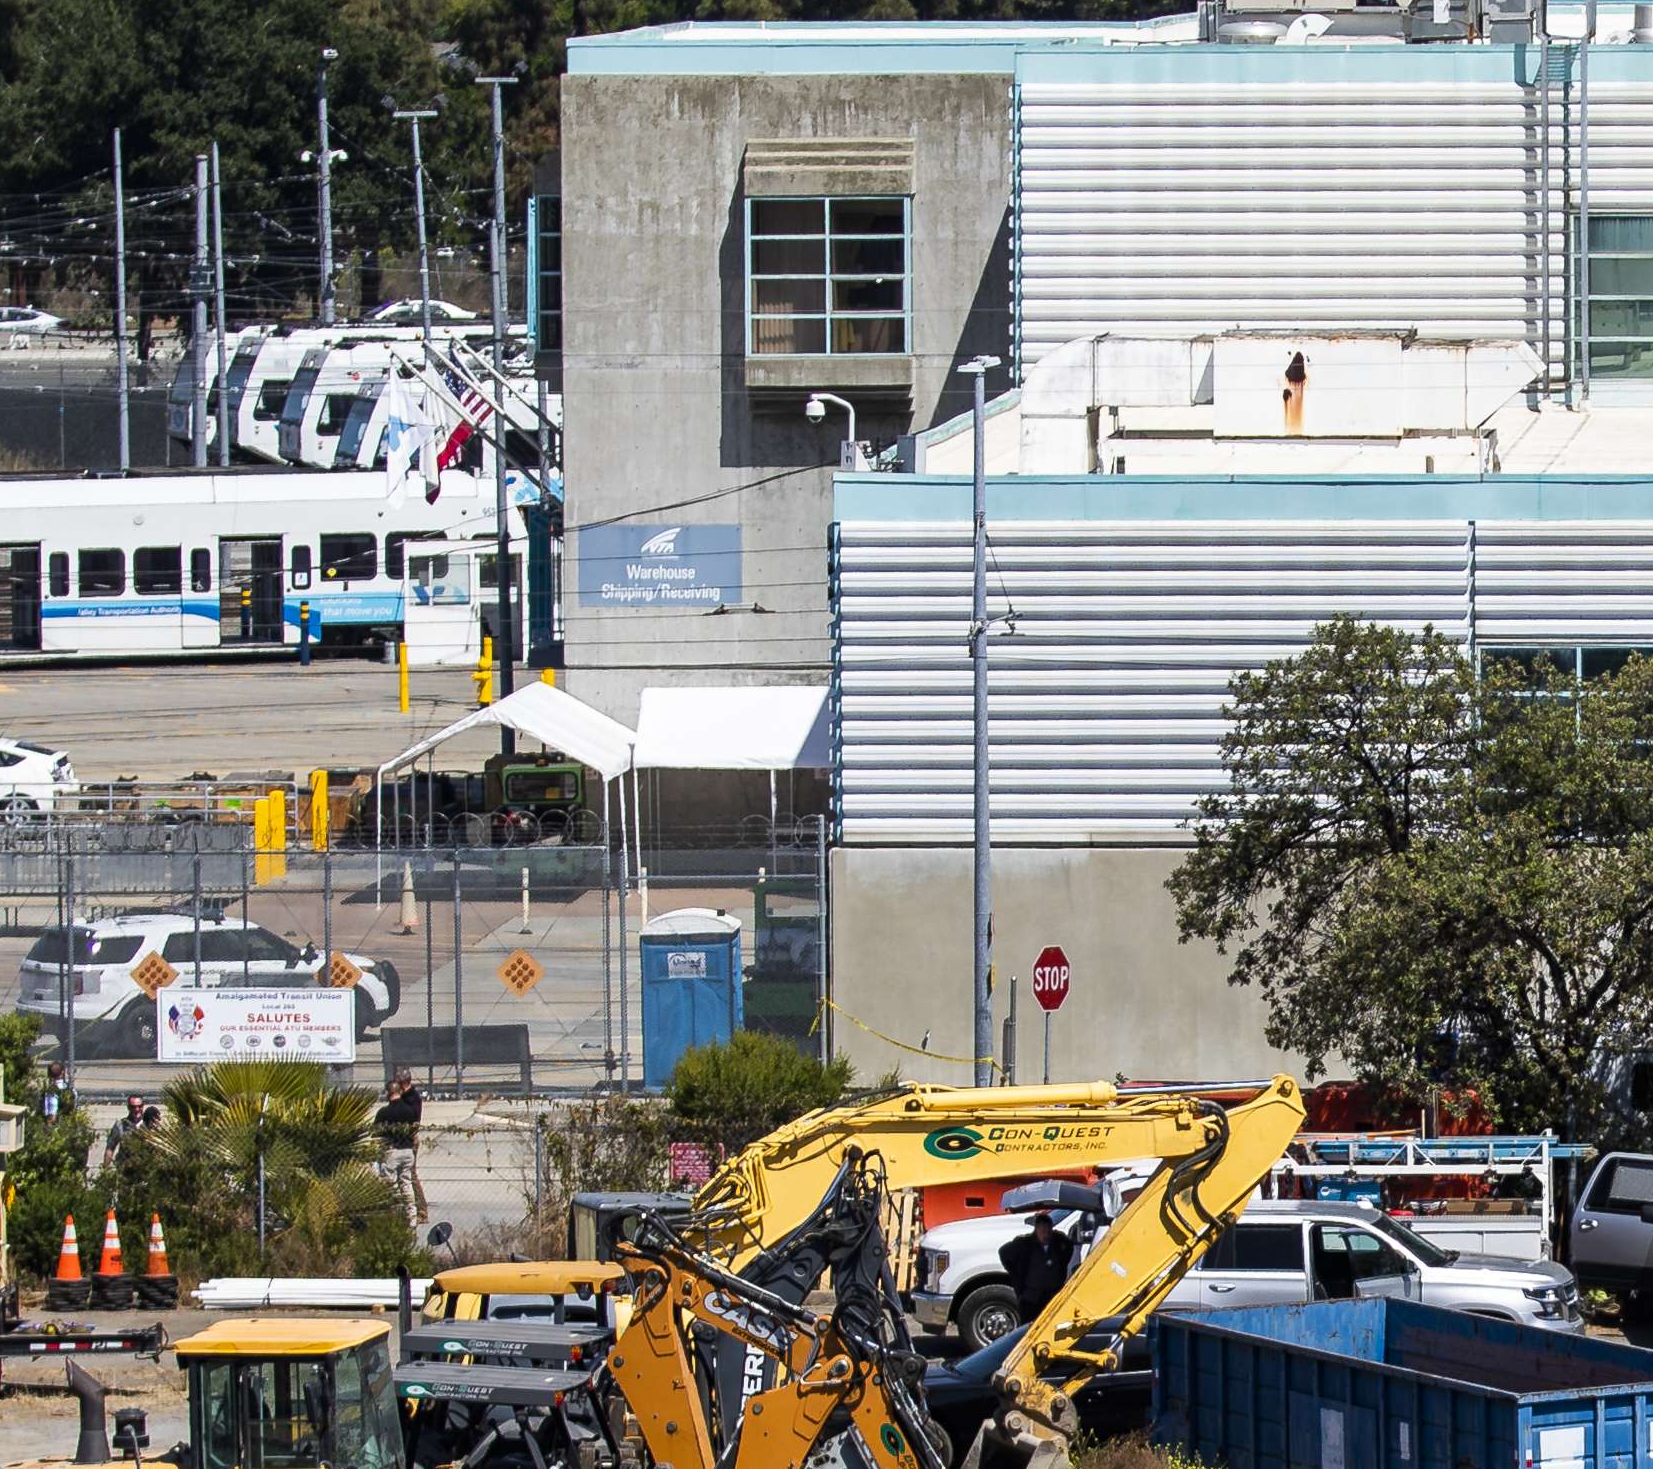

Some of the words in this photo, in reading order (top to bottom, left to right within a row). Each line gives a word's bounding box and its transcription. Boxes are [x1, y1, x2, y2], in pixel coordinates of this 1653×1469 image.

[626, 564, 696, 580] Warehouse
[601, 583, 721, 602] Shipping/Receiving
[1035, 966, 1069, 991] STOP
[215, 992, 278, 1002] Amalgamated
[281, 992, 313, 1000] Transit
[315, 992, 342, 1000] Union
[247, 1013, 311, 1023] SALUTES
[988, 1126, 1115, 1140] CON-QUEST
